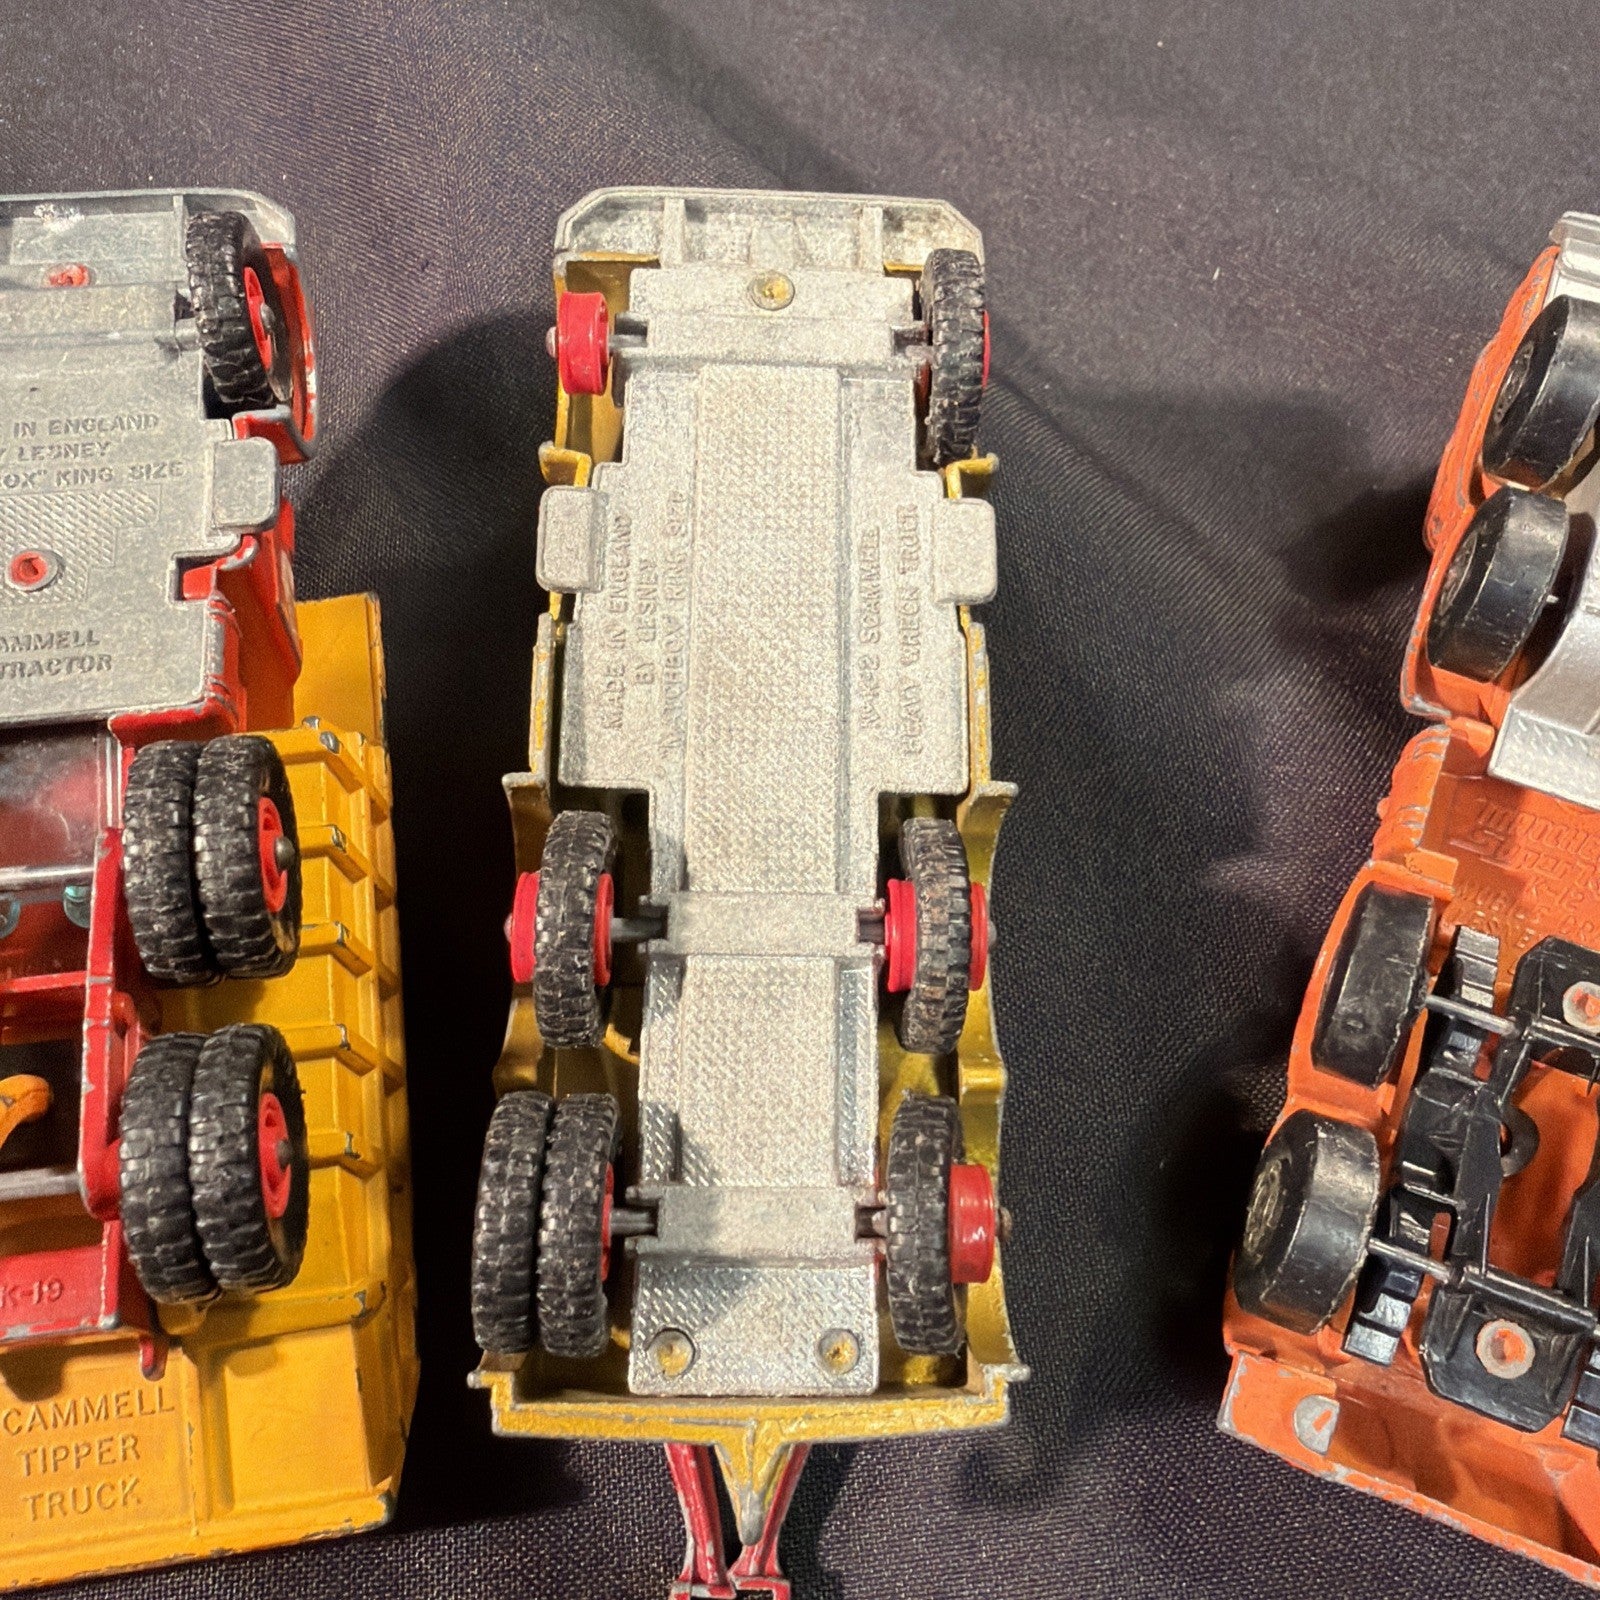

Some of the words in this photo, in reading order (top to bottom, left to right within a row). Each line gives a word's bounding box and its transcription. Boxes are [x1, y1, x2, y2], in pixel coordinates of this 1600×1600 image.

[13, 421, 38, 438] IN
[49, 414, 159, 436] ENGLAND
[17, 440, 112, 462] LESNEY
[56, 467, 114, 486] KING
[128, 460, 190, 482] SIZE
[607, 513, 632, 613] ENGLAND
[634, 558, 658, 643] LESNEY
[2, 1385, 176, 1436] CAMMELL
[18, 1433, 141, 1478] TIPPER
